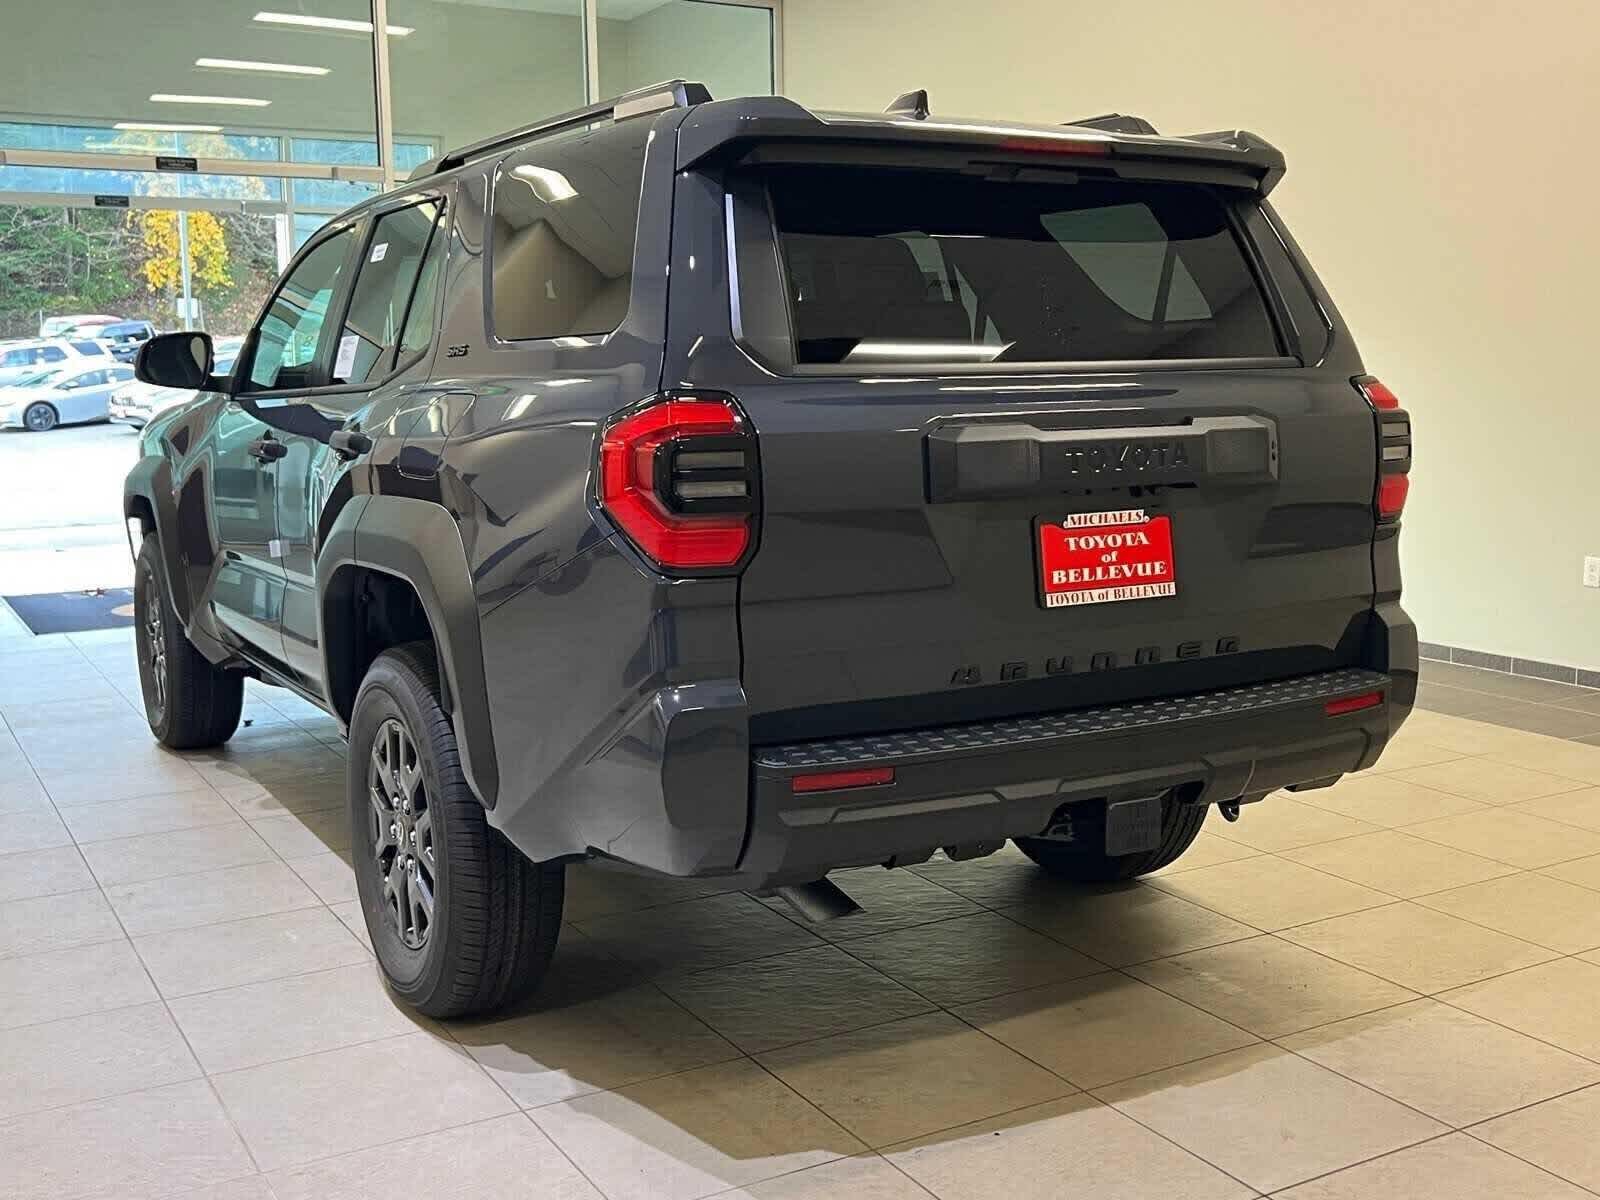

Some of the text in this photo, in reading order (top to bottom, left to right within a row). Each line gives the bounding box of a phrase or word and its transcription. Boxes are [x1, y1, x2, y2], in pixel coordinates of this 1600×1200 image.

[1064, 442, 1189, 474] TOYOTA
[1070, 511, 1143, 526] MICHAELS
[1064, 532, 1150, 551] TOYOTA
[1100, 550, 1119, 563] of
[1052, 560, 1167, 585] BELLEVUE
[1048, 583, 1175, 606] TOYOTA of BELLEVUE
